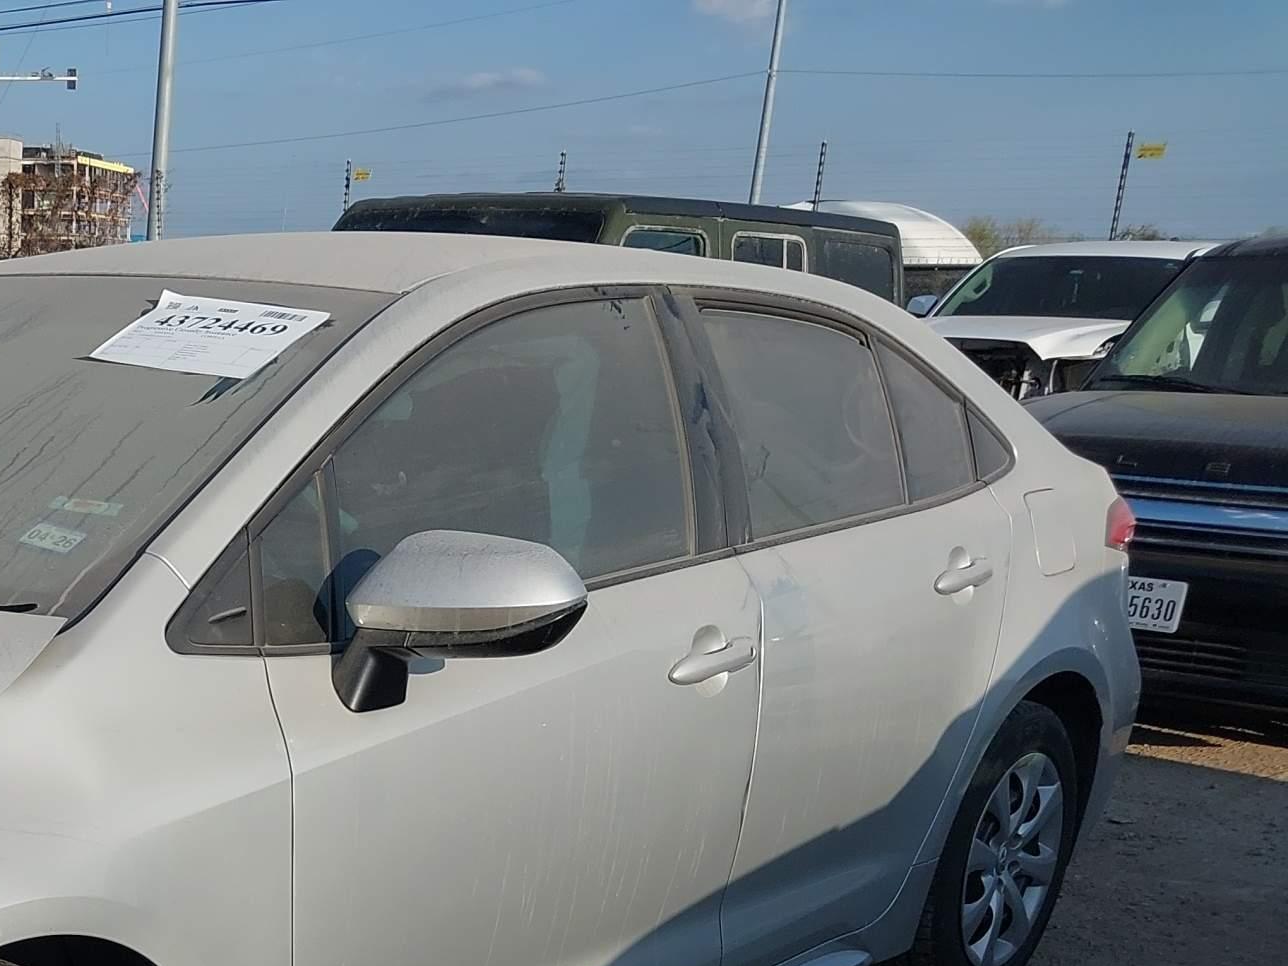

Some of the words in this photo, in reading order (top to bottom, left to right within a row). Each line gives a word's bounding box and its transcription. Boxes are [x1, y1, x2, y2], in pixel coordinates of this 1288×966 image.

[155, 314, 289, 336] 43724469
[1129, 580, 1154, 592] XAS
[1128, 595, 1177, 622] 5630
